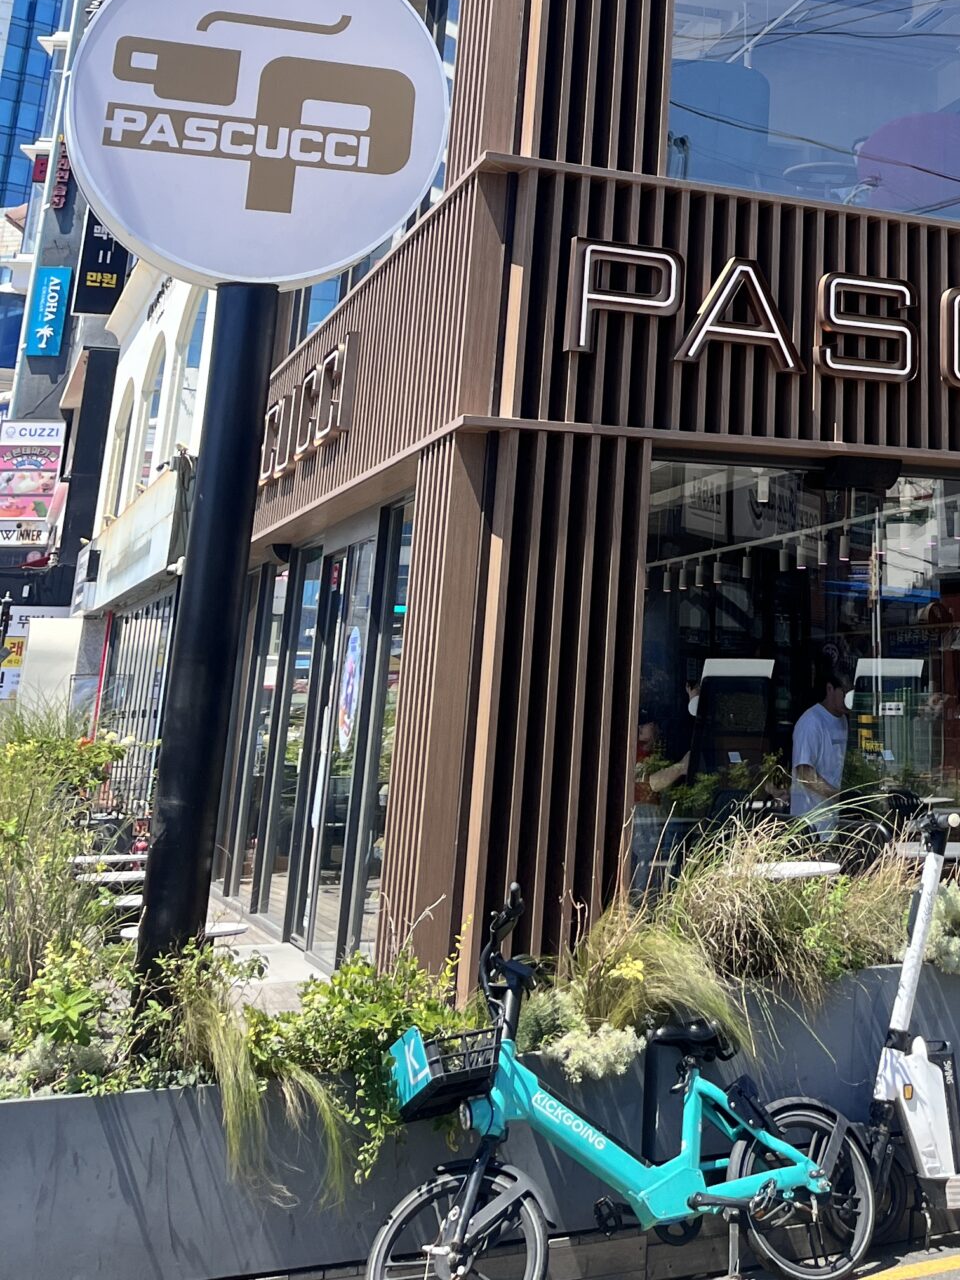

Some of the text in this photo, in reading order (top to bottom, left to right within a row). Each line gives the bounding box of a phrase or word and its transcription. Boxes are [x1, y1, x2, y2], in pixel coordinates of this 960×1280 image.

[103, 108, 371, 168] PASCUCCI
[44, 276, 62, 322] ALOHA
[86, 271, 118, 288] 만원
[258, 331, 361, 487] CUCCI
[18, 427, 60, 438] CUZZI
[0, 529, 42, 541] WINNER
[531, 1091, 606, 1151] KICKGOING
